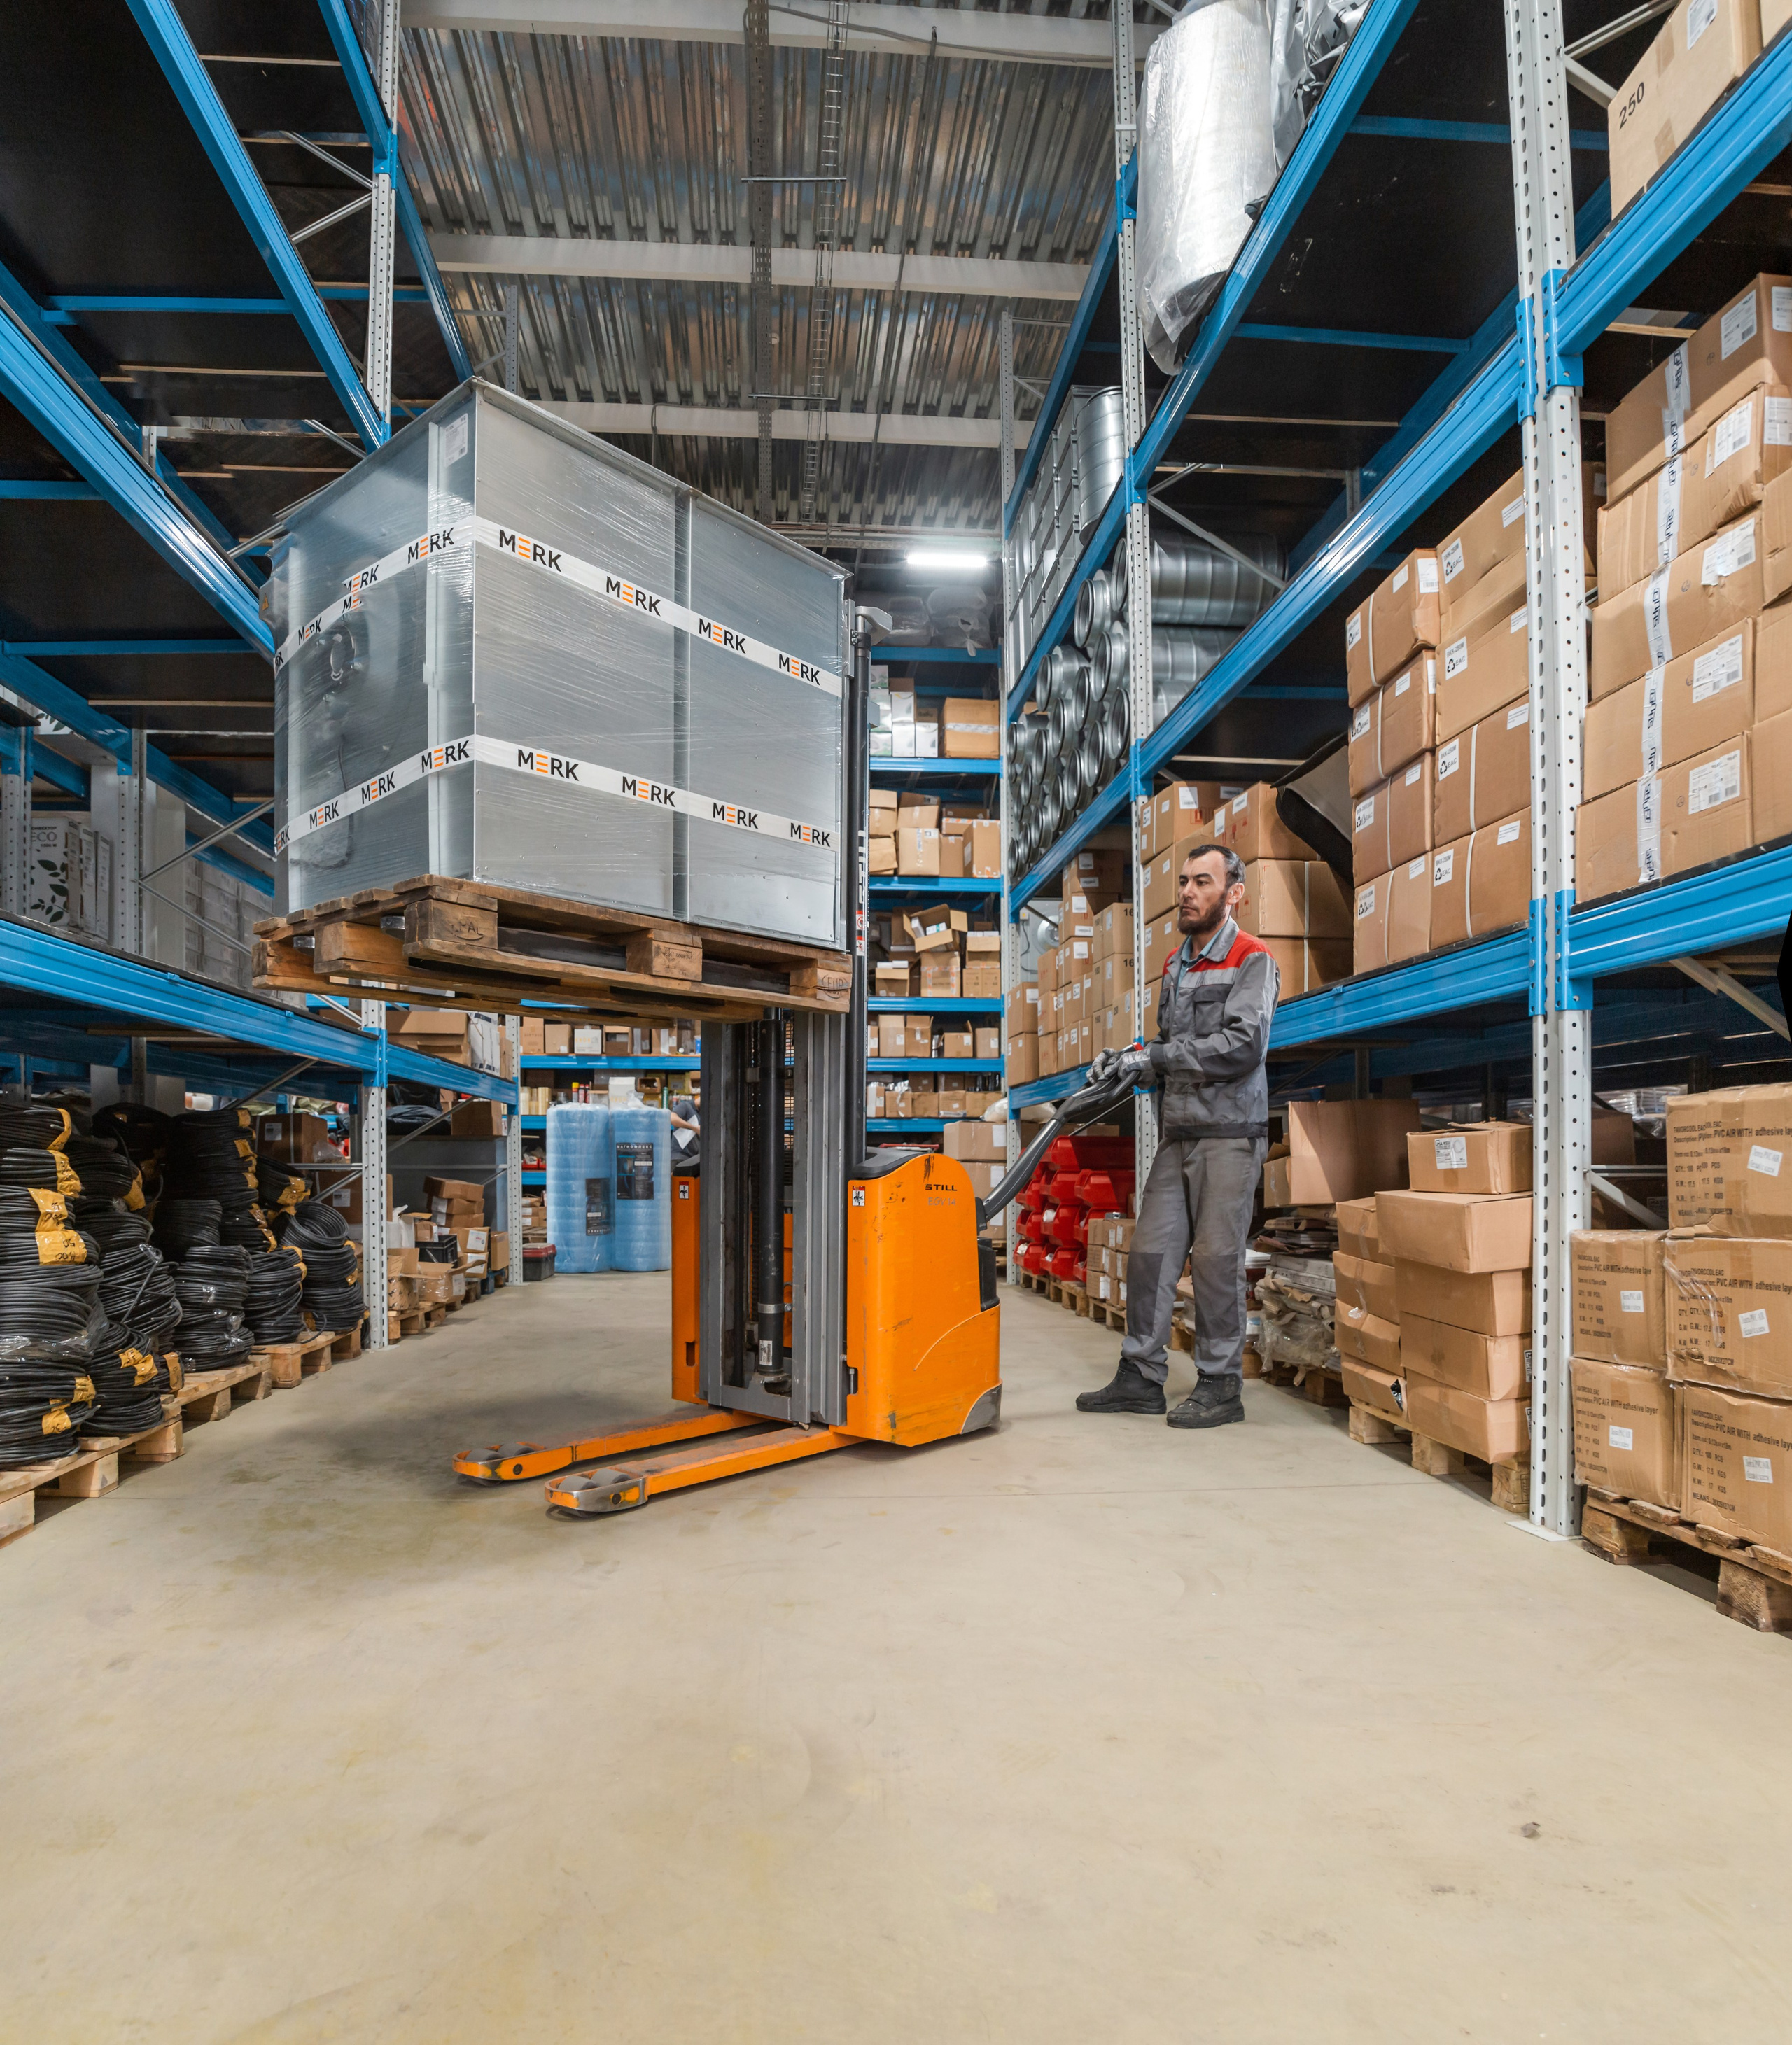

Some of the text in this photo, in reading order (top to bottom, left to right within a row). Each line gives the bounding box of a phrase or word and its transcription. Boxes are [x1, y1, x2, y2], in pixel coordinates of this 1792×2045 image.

[1618, 82, 1644, 131] 250
[407, 527, 455, 564] MERK
[499, 530, 561, 572] MERK
[1453, 556, 1462, 568] EAC
[606, 577, 661, 617] MERK
[699, 619, 746, 654] MERK
[779, 654, 820, 686] MERK
[1456, 655, 1466, 667] EAC
[421, 740, 470, 773] MERK
[517, 749, 579, 781] MERK
[1448, 757, 1457, 768] EAC
[361, 771, 396, 804] MERK
[622, 776, 676, 807] MERK
[309, 800, 340, 829] MERK
[713, 803, 758, 829] MERK
[790, 823, 831, 847] MERK
[1442, 868, 1451, 876] EAC
[1714, 1128, 1726, 1138] PVC
[1726, 1128, 1736, 1138] AIR
[1737, 1127, 1753, 1137] WITH
[1756, 1125, 1784, 1137] adhesive
[928, 1197, 956, 1206] EGV 14
[1611, 1265, 1621, 1273] WITH
[1621, 1265, 1642, 1274] adhesive
[1716, 1278, 1727, 1287] PVC
[1728, 1279, 1737, 1288] AIR
[1739, 1279, 1753, 1289] WITH
[1755, 1281, 1782, 1292] adhesive
[1611, 1399, 1623, 1408] WITH
[1623, 1402, 1644, 1412] adhesive
[1645, 1405, 1658, 1416] layer
[1716, 1422, 1726, 1433] PVC
[1727, 1426, 1736, 1436] AIR
[1737, 1428, 1751, 1440] WITH
[1754, 1433, 1780, 1447] adhesive
[1715, 1454, 1723, 1463] PCS
[1717, 1470, 1726, 1479] KGS
[1717, 1484, 1726, 1494] KGS
